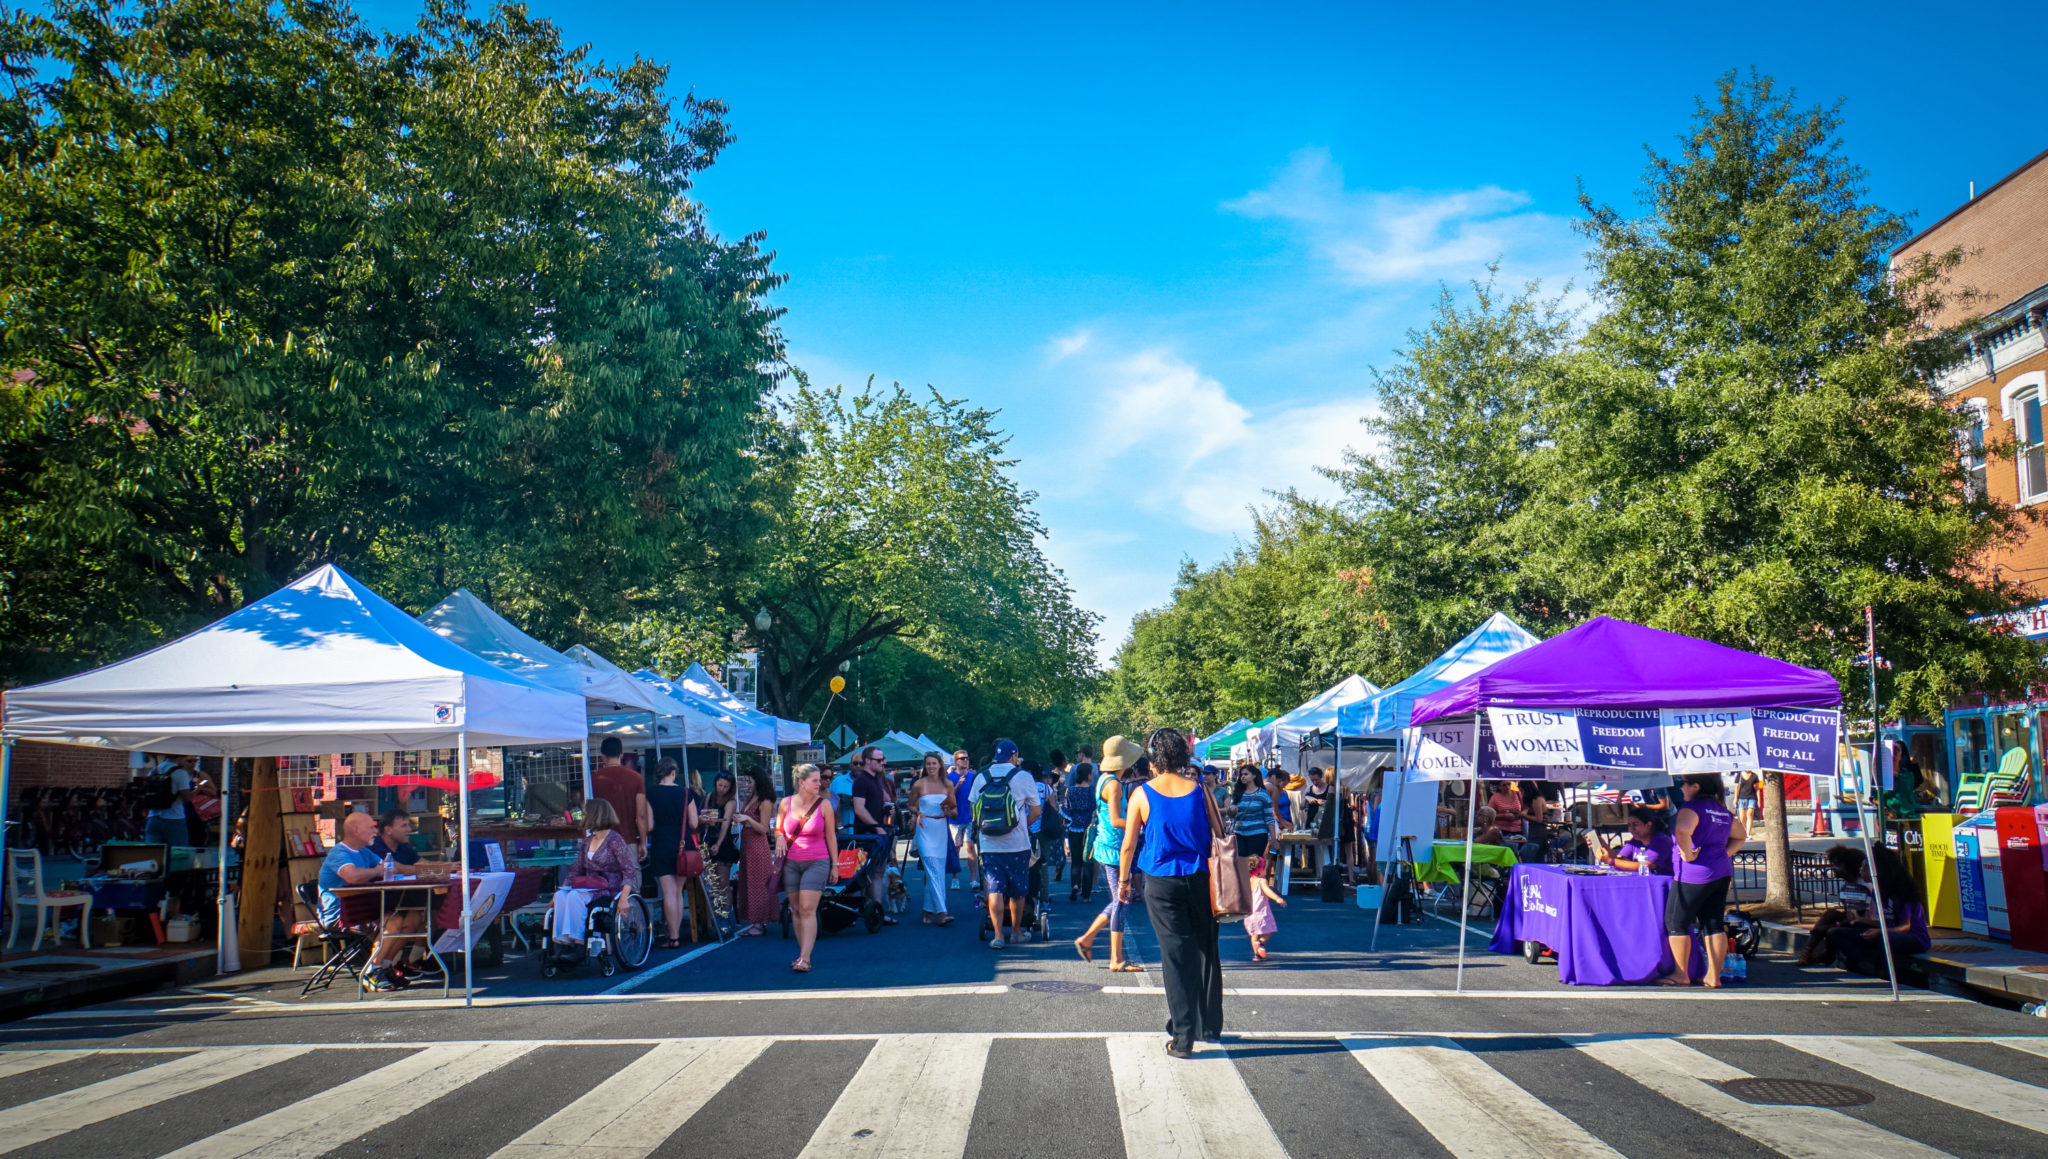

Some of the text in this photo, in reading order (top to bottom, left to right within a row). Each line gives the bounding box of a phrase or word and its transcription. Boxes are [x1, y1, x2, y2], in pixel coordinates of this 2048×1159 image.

[1502, 712, 1565, 726] TRUST
[1576, 707, 1660, 719] REPRODUCTIVE
[1674, 712, 1739, 730] TRUST
[1751, 707, 1837, 727] REPRODUCTIVE
[1414, 731, 1464, 747] TRUST
[1592, 726, 1646, 738] FREEDOM
[1763, 727, 1820, 743] FREEDOM
[1502, 738, 1579, 752] WOMEN
[1598, 744, 1644, 757] FOR ALL
[1671, 741, 1751, 760] WOMEN
[1766, 746, 1816, 762] FOR ALL
[1408, 755, 1473, 771] WOMEN
[1956, 840, 1971, 912] APARTMENT
